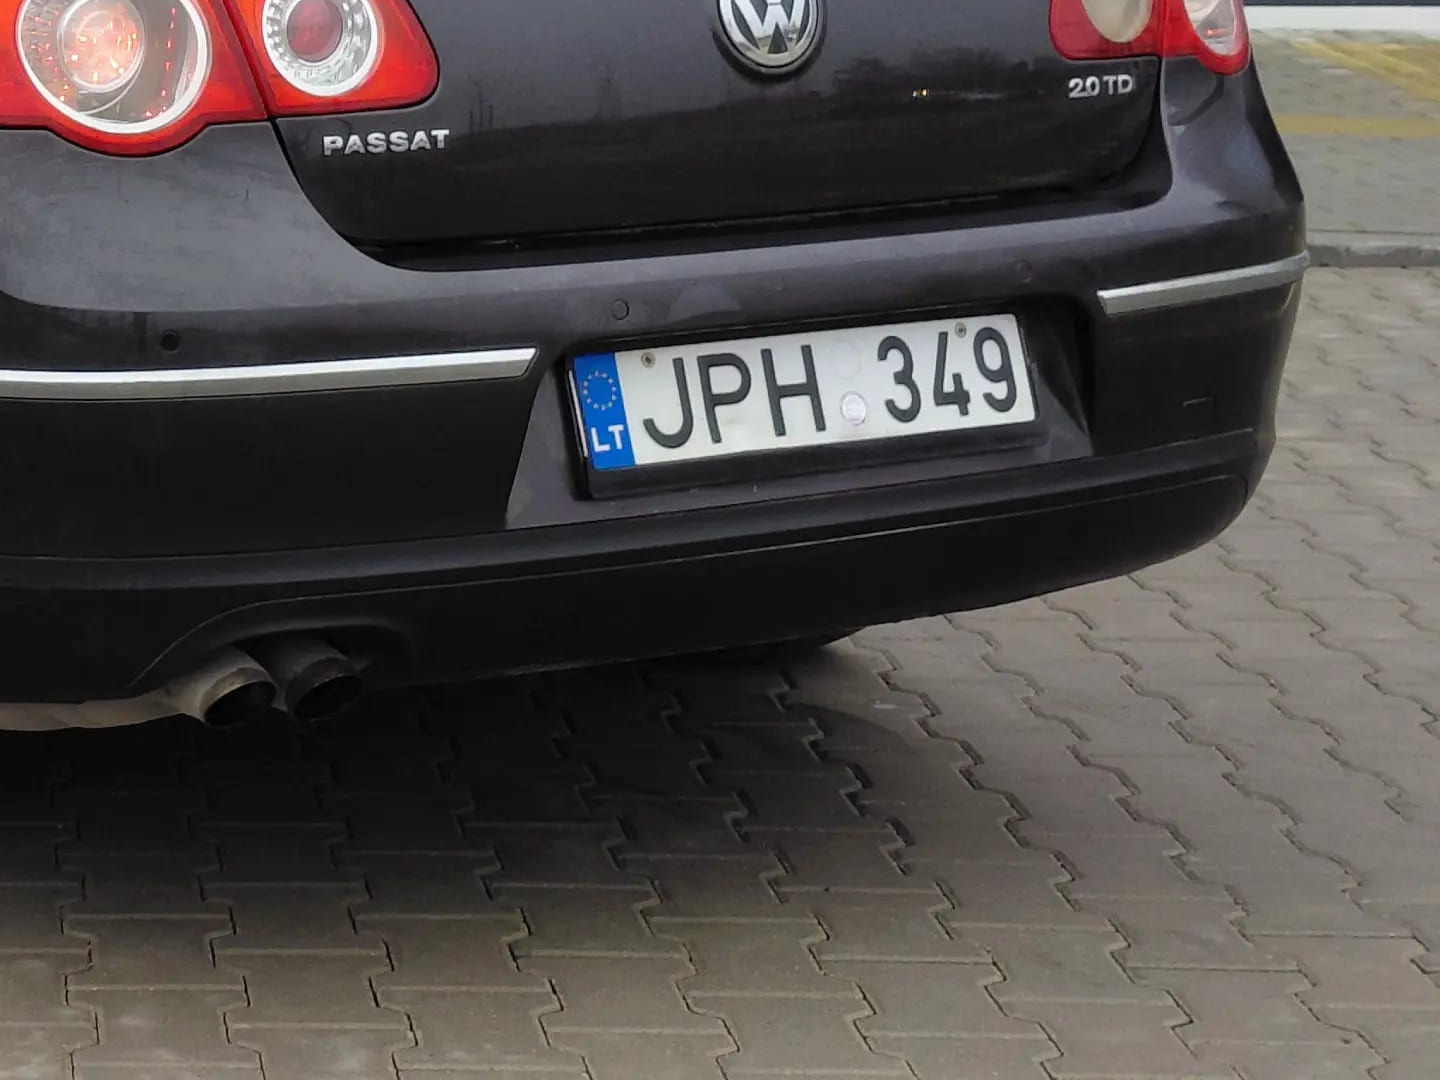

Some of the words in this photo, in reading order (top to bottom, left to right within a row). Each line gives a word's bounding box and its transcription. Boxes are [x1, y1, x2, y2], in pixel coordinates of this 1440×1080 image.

[323, 129, 450, 156] PASSAT
[643, 344, 826, 448] JPH
[877, 327, 1017, 422] 349
[591, 424, 625, 452] LT
